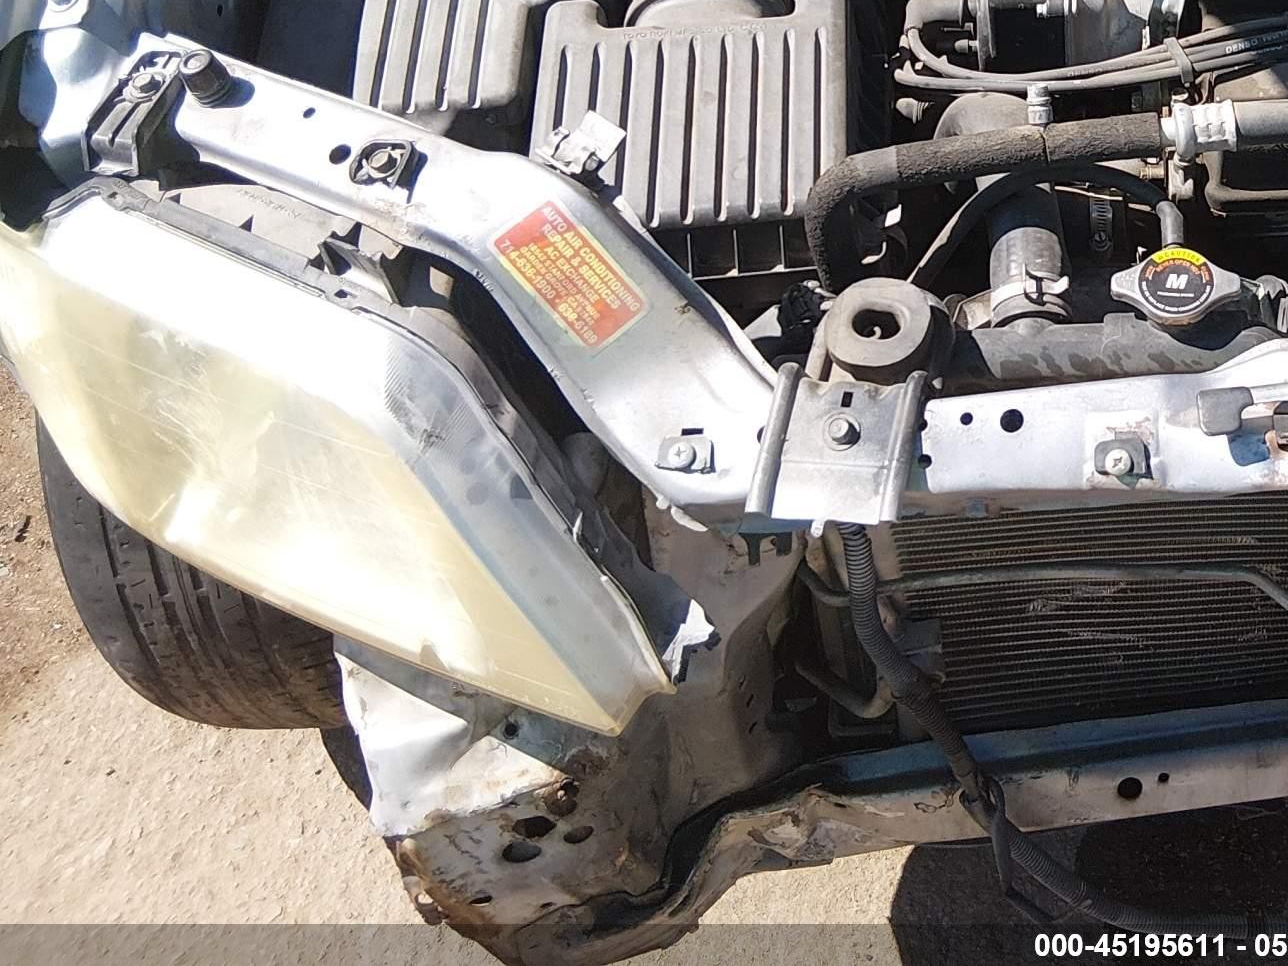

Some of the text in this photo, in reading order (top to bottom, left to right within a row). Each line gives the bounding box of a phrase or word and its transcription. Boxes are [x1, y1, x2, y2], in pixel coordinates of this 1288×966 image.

[1225, 37, 1258, 54] DENSO
[520, 246, 547, 274] GARDEN
[567, 296, 578, 307] CA
[541, 224, 622, 309] REPAIR & SERVICES
[543, 207, 640, 311] AUTO AIR CONDITIONING
[544, 246, 600, 302] AC EXCHANGE
[1164, 250, 1201, 263] CAUTION
[544, 260, 577, 294] STANFORD
[576, 294, 600, 319] AVENUE
